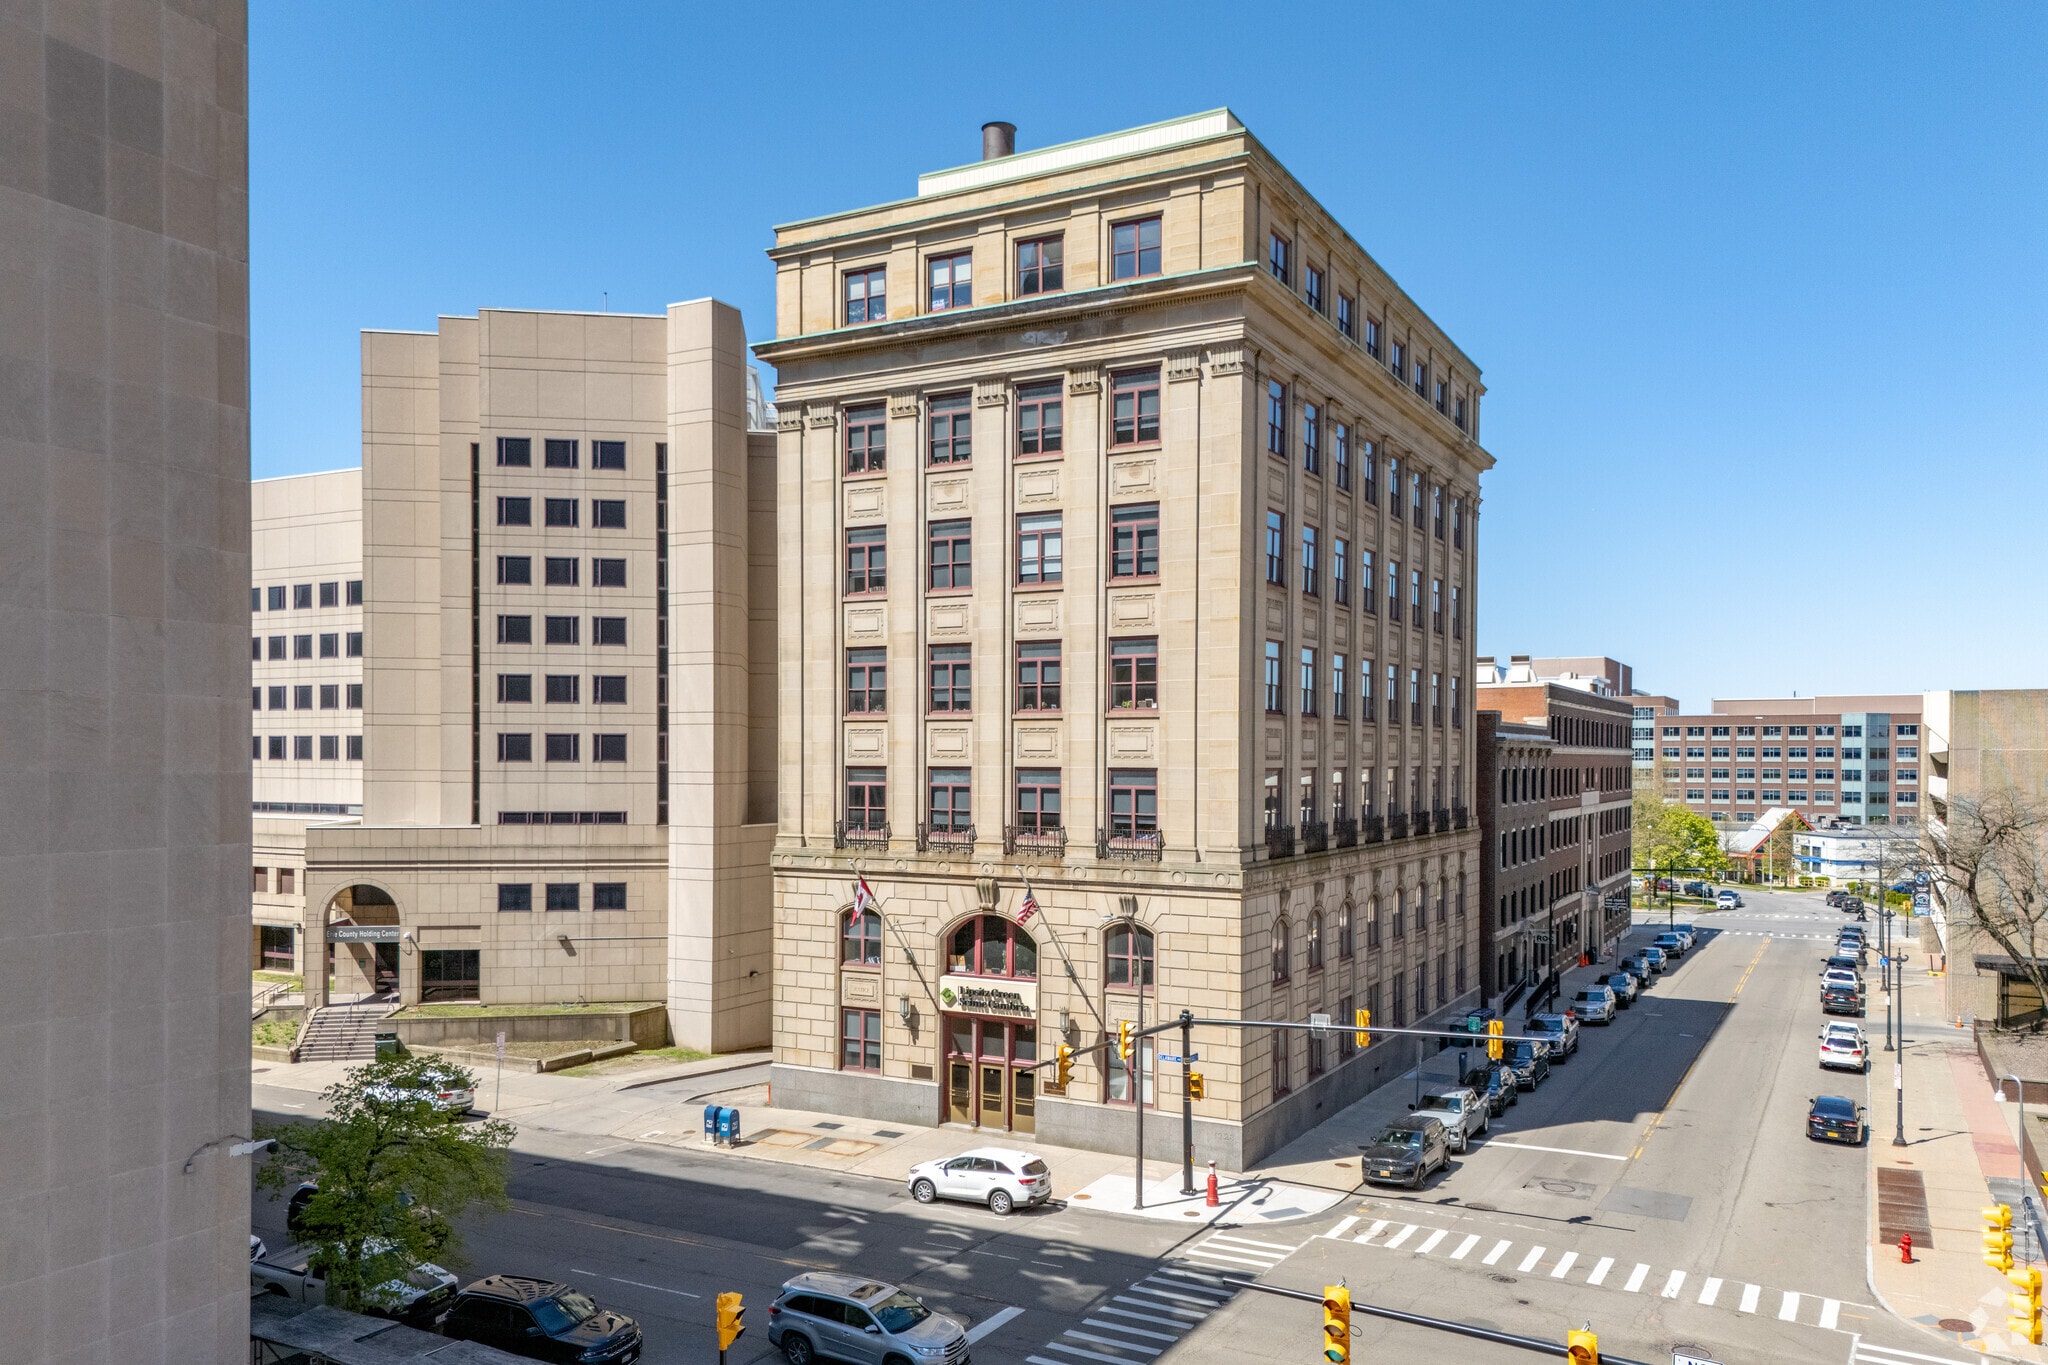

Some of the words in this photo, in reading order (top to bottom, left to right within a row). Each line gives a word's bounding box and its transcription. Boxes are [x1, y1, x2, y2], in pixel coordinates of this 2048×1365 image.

[338, 931, 359, 939] County
[359, 930, 381, 939] Holding
[381, 930, 399, 938] Center
[959, 985, 990, 997] Lipsitz
[990, 988, 1021, 1000] Green
[988, 1000, 1030, 1013] Cambria
